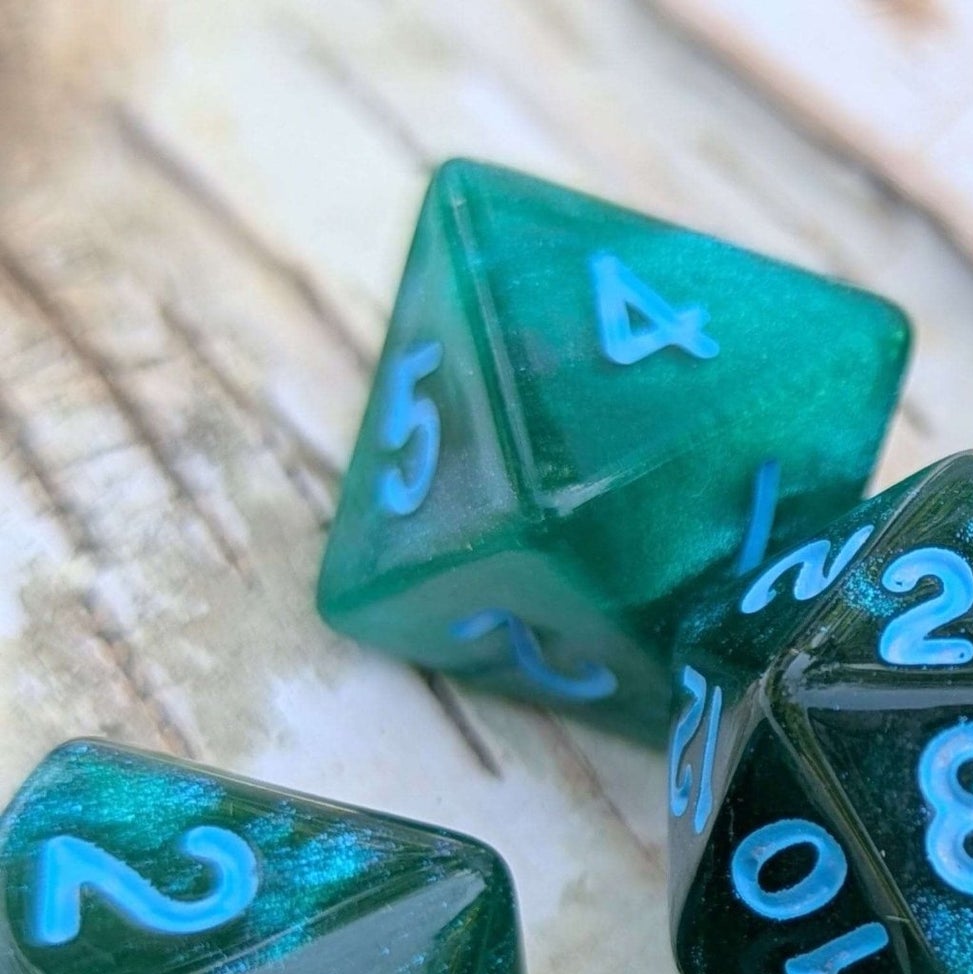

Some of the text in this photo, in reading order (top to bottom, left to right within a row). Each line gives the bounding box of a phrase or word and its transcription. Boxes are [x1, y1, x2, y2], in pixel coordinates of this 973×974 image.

[588, 247, 721, 366] 4
[375, 340, 444, 517] 5
[741, 524, 875, 615] 2
[33, 825, 260, 947] 2
